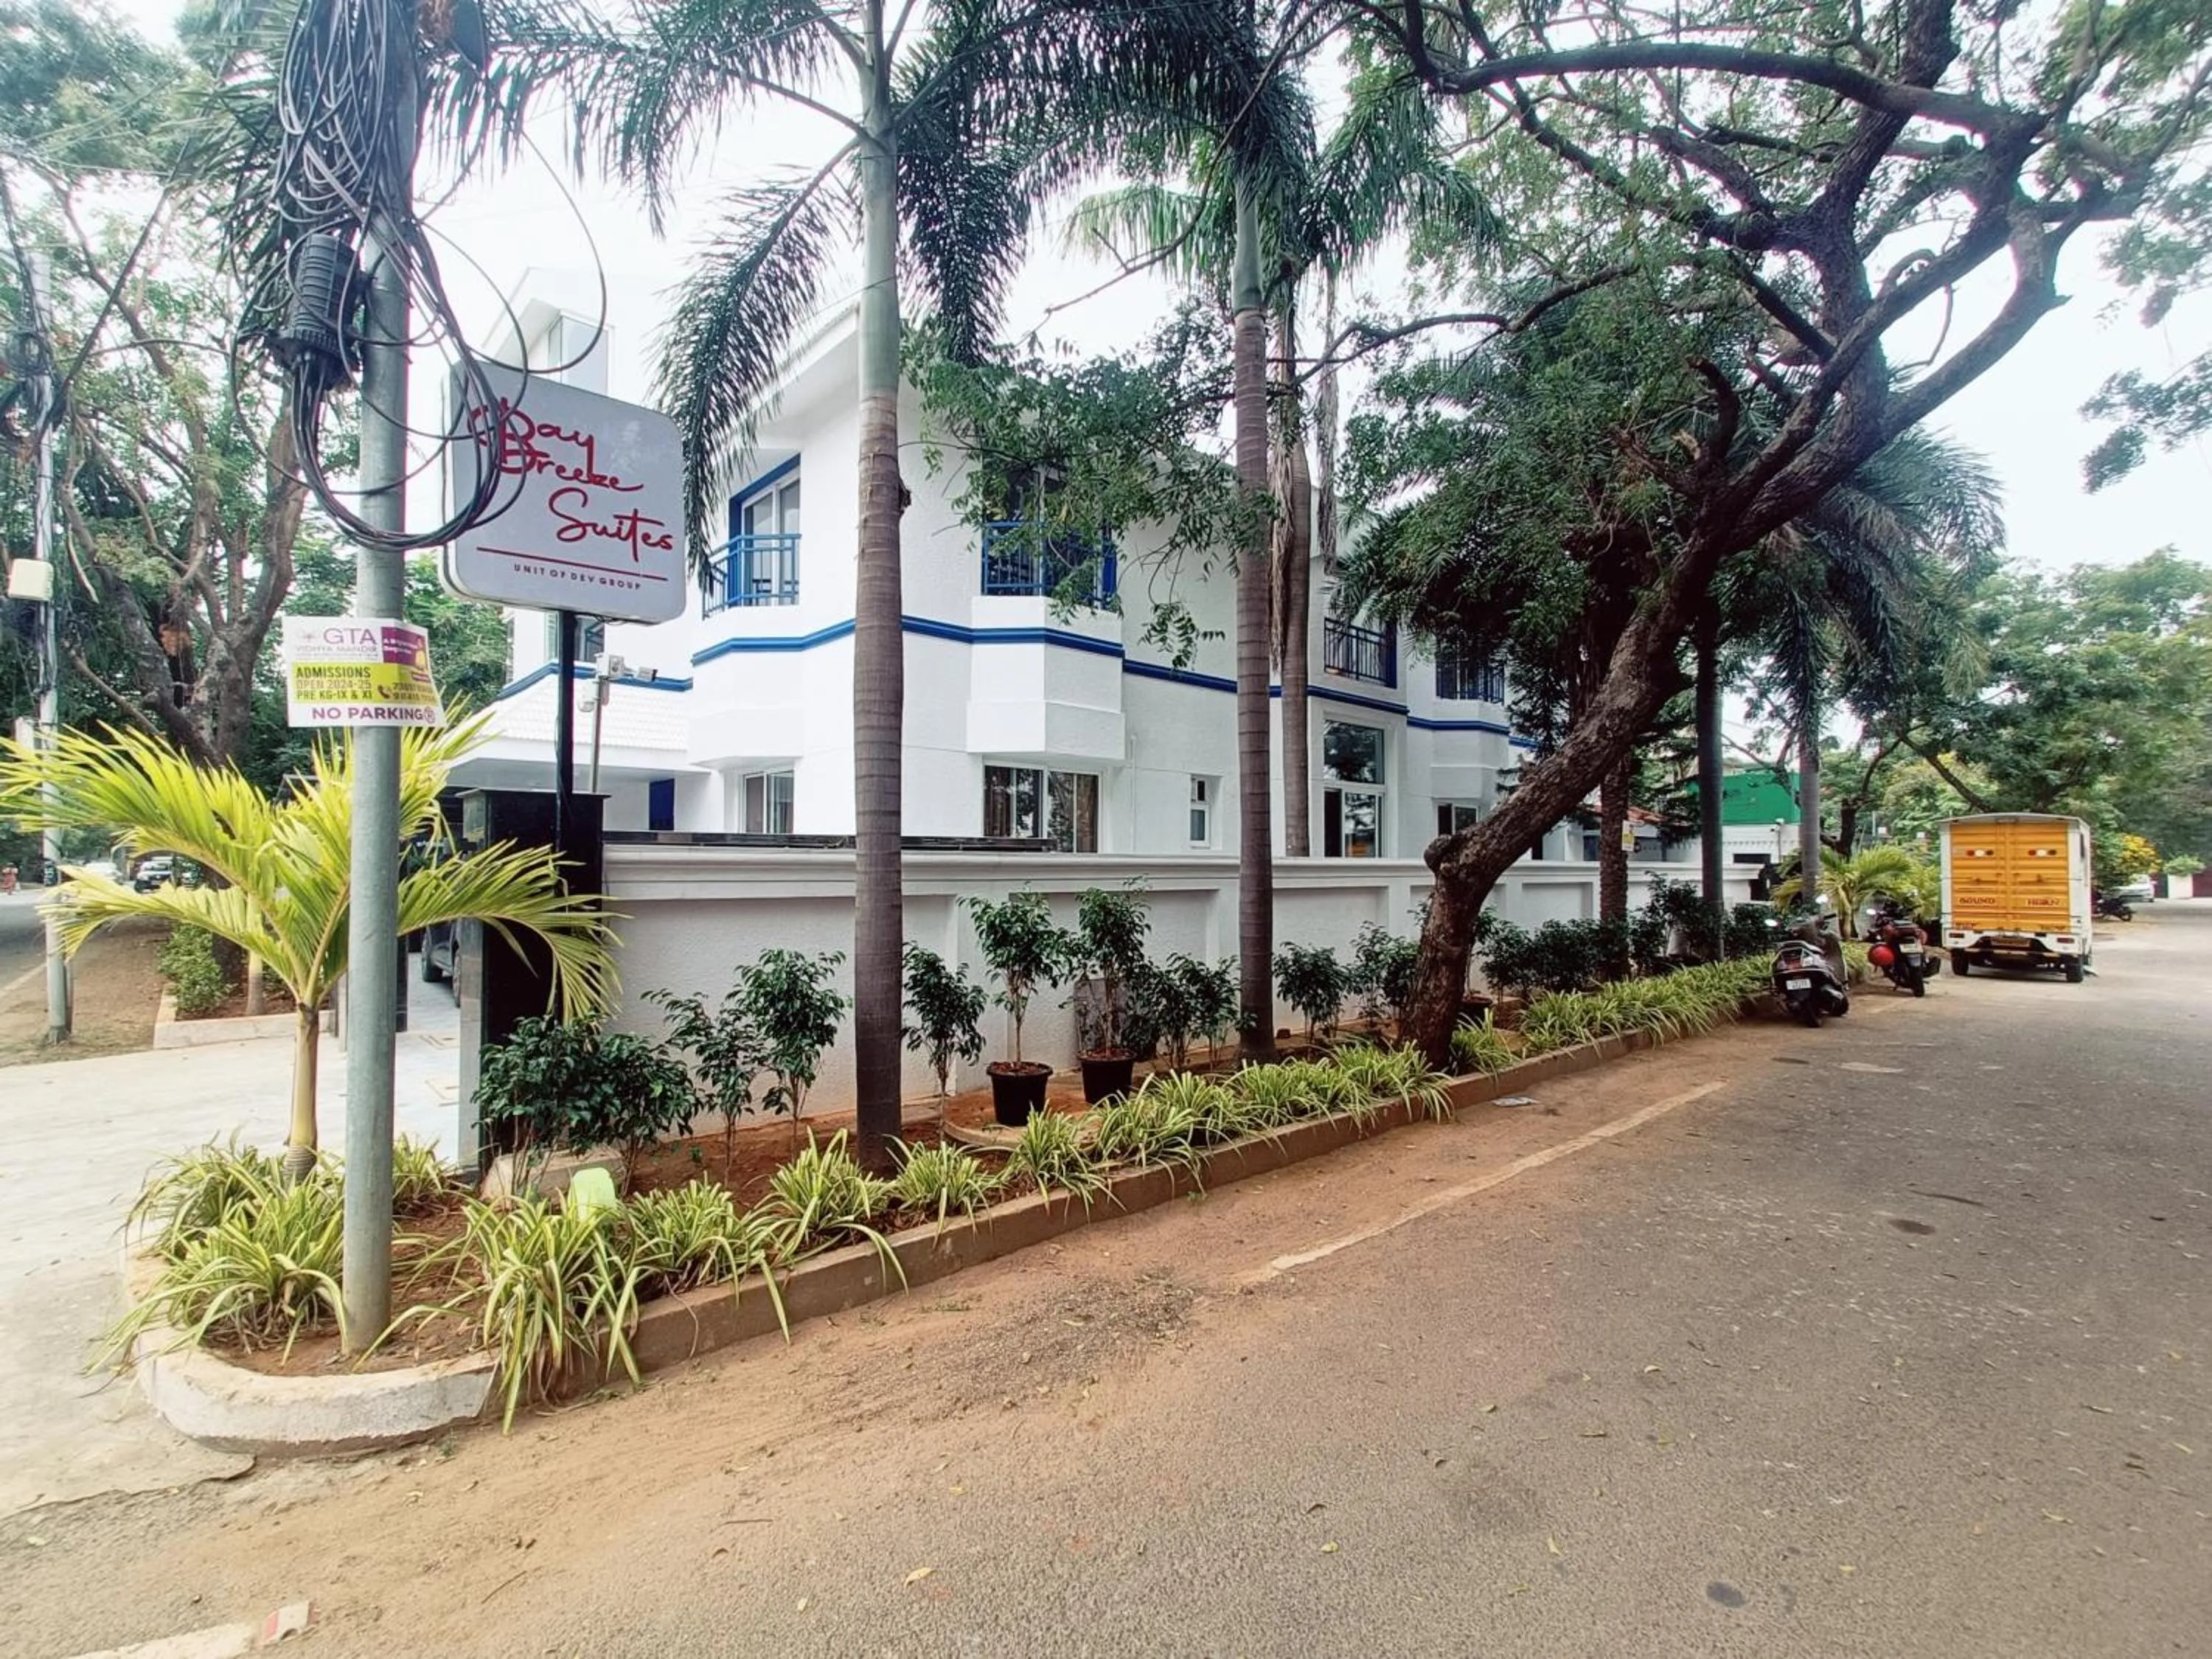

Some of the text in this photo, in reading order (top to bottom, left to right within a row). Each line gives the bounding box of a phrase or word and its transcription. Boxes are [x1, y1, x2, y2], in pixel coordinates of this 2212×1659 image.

[467, 397, 594, 479] Bay
[549, 487, 672, 563] Suites
[514, 563, 641, 590] UNIT OF DEV GROUP
[323, 627, 378, 644] GTA
[296, 666, 371, 678] ADMISSIONS
[296, 679, 372, 689] OPEN 2024-25
[296, 689, 316, 700] PRE
[319, 689, 347, 700] KG-IX
[362, 689, 372, 700] XI
[312, 706, 422, 720] NO PARKING
